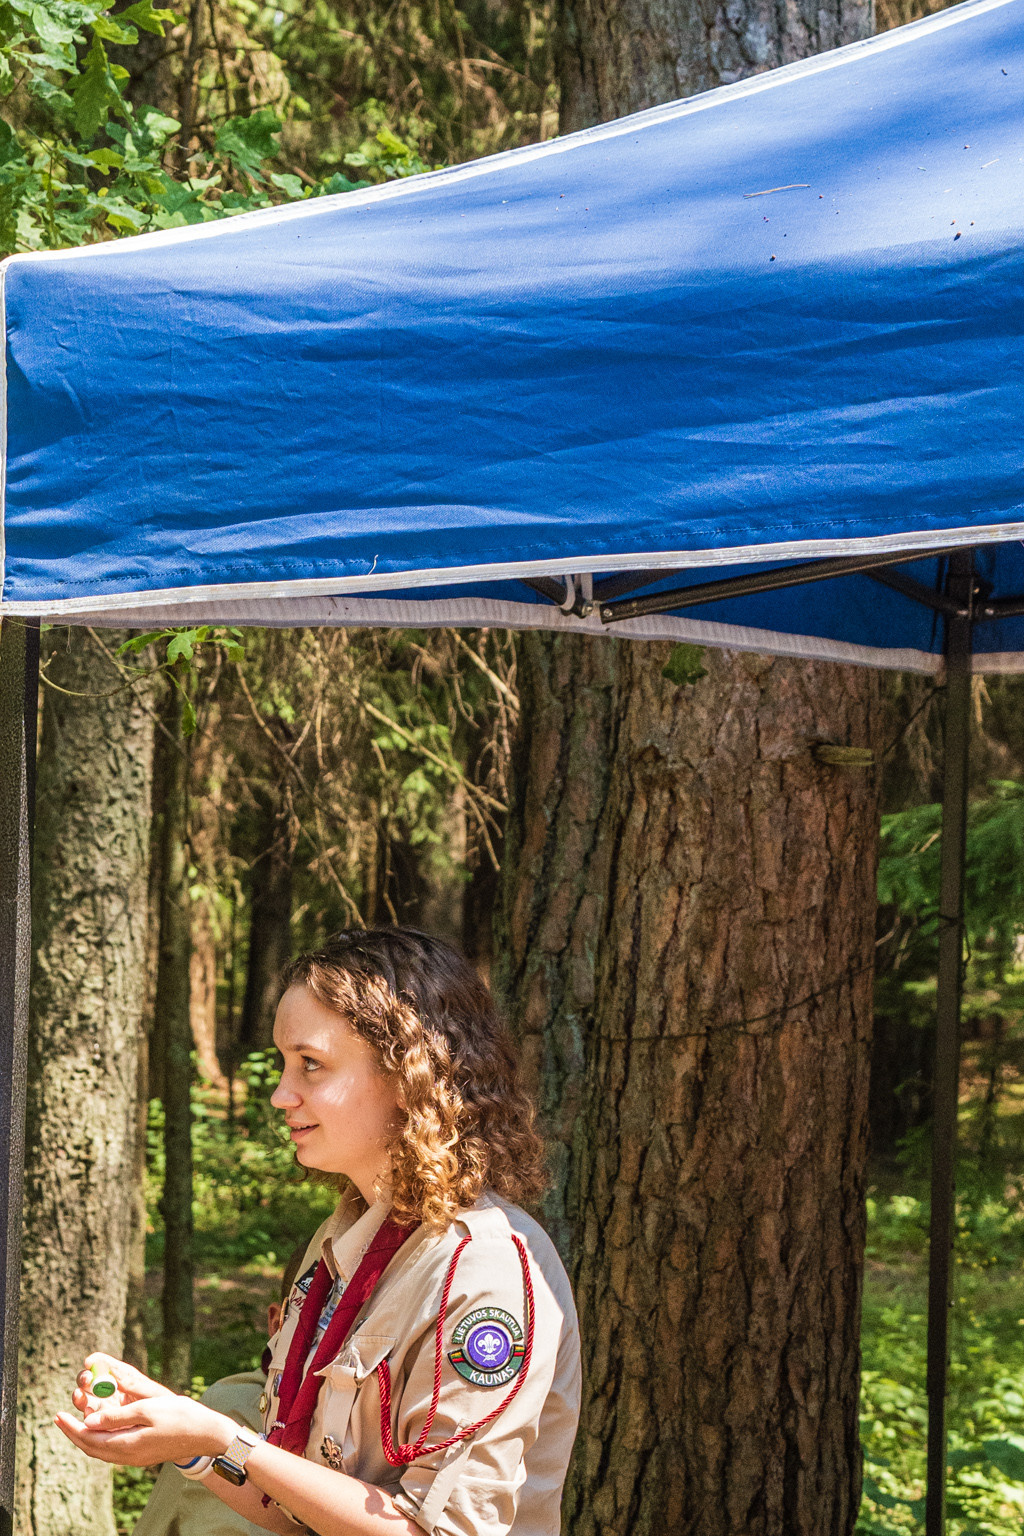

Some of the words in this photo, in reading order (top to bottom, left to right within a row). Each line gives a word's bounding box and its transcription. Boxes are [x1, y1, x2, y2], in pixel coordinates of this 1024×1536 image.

[456, 1309, 487, 1341] LIETUVOS
[489, 1309, 521, 1337] SKAUTIJA
[469, 1366, 515, 1385] KAUNAS
